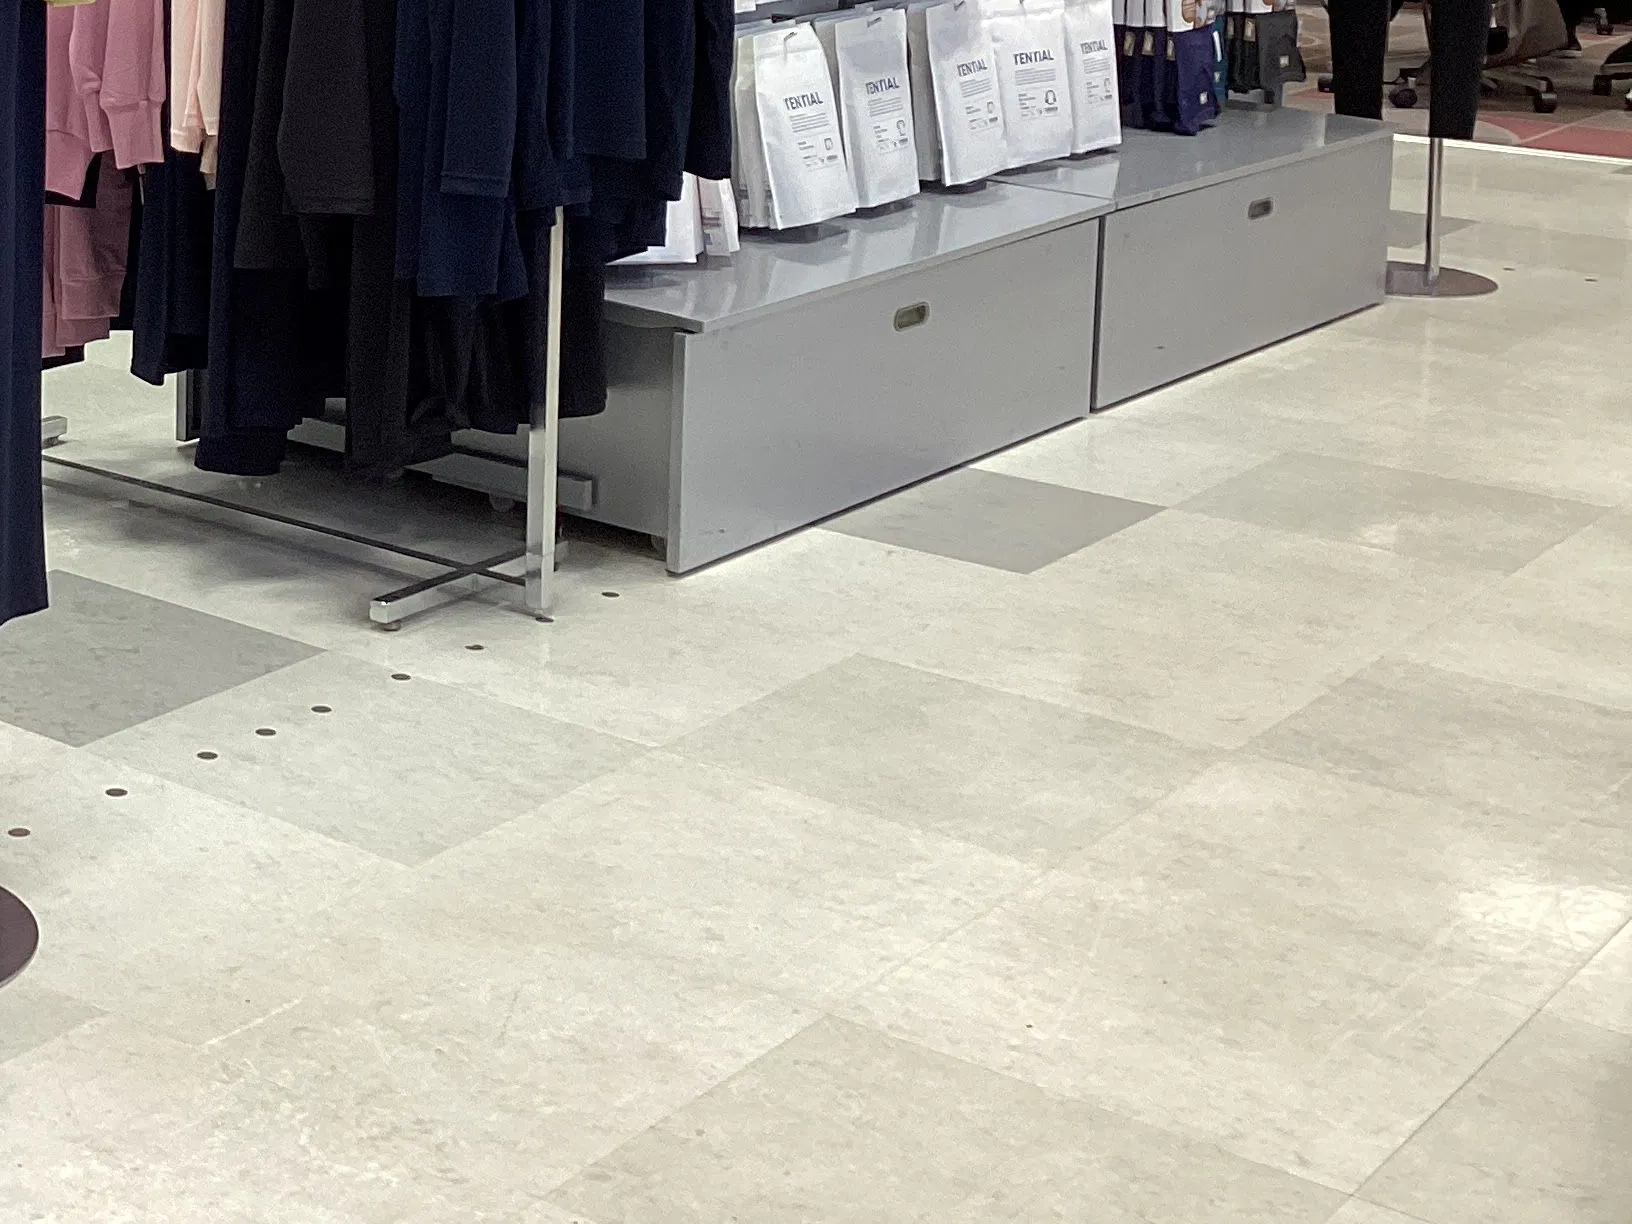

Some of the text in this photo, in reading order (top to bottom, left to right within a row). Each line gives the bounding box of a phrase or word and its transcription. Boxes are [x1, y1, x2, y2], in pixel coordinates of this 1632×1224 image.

[1013, 49, 1054, 66] TENTIAL
[957, 59, 987, 77] TENTIAL
[866, 76, 900, 95] TENTIAL
[784, 92, 824, 111] TENTIAL
